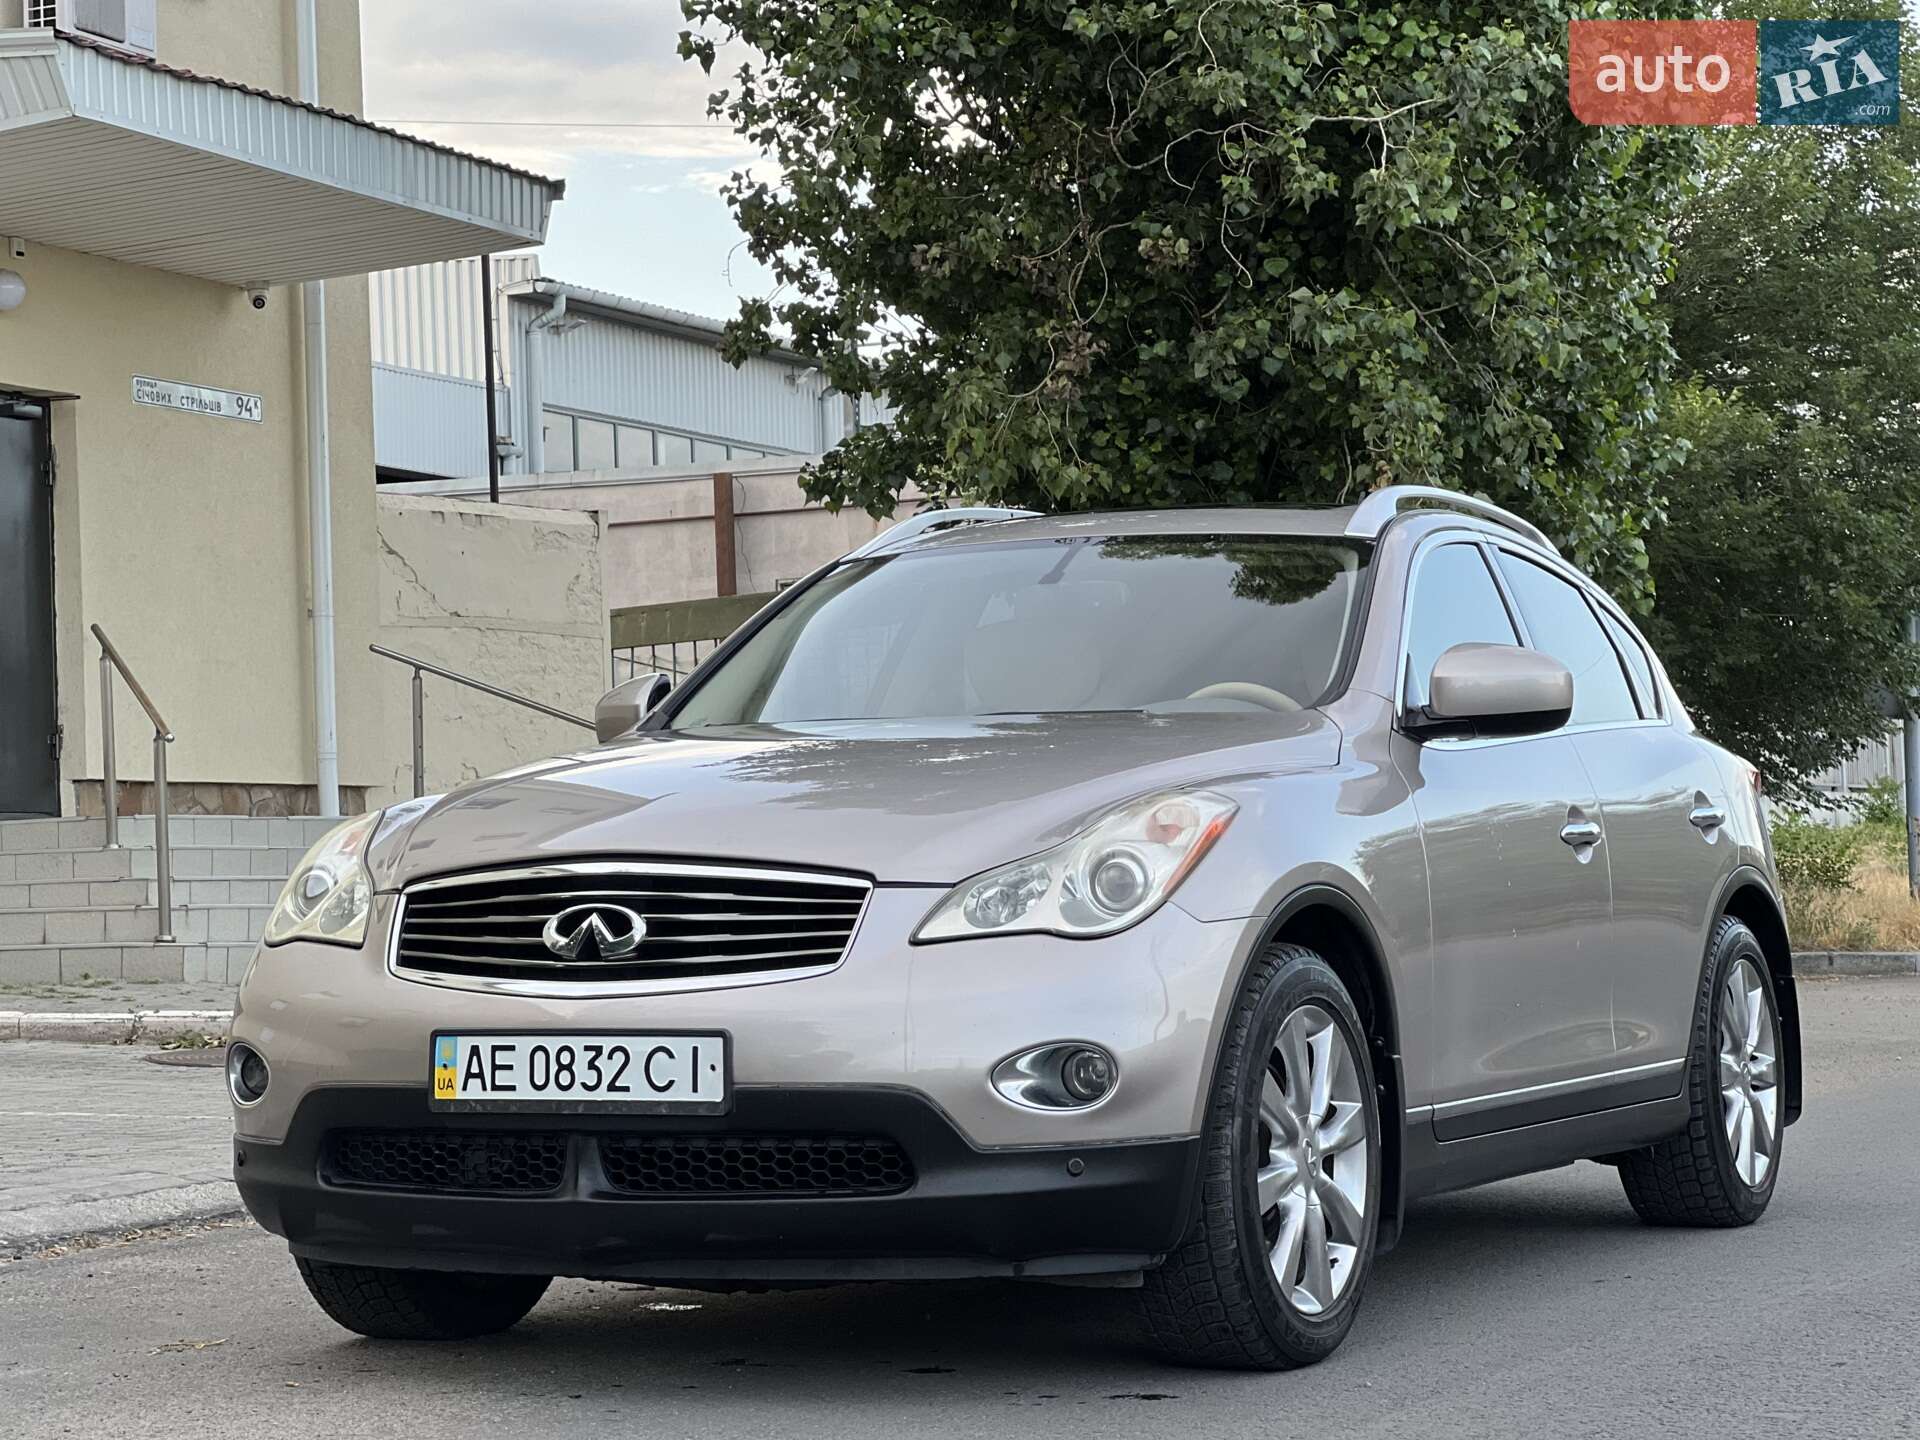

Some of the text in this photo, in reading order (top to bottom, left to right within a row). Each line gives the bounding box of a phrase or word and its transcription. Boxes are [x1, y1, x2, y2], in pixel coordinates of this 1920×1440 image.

[136, 388, 173, 404] СІЧОВИХ
[461, 1044, 517, 1092] AE
[529, 1044, 632, 1093] 0832
[437, 1079, 455, 1091] UA
